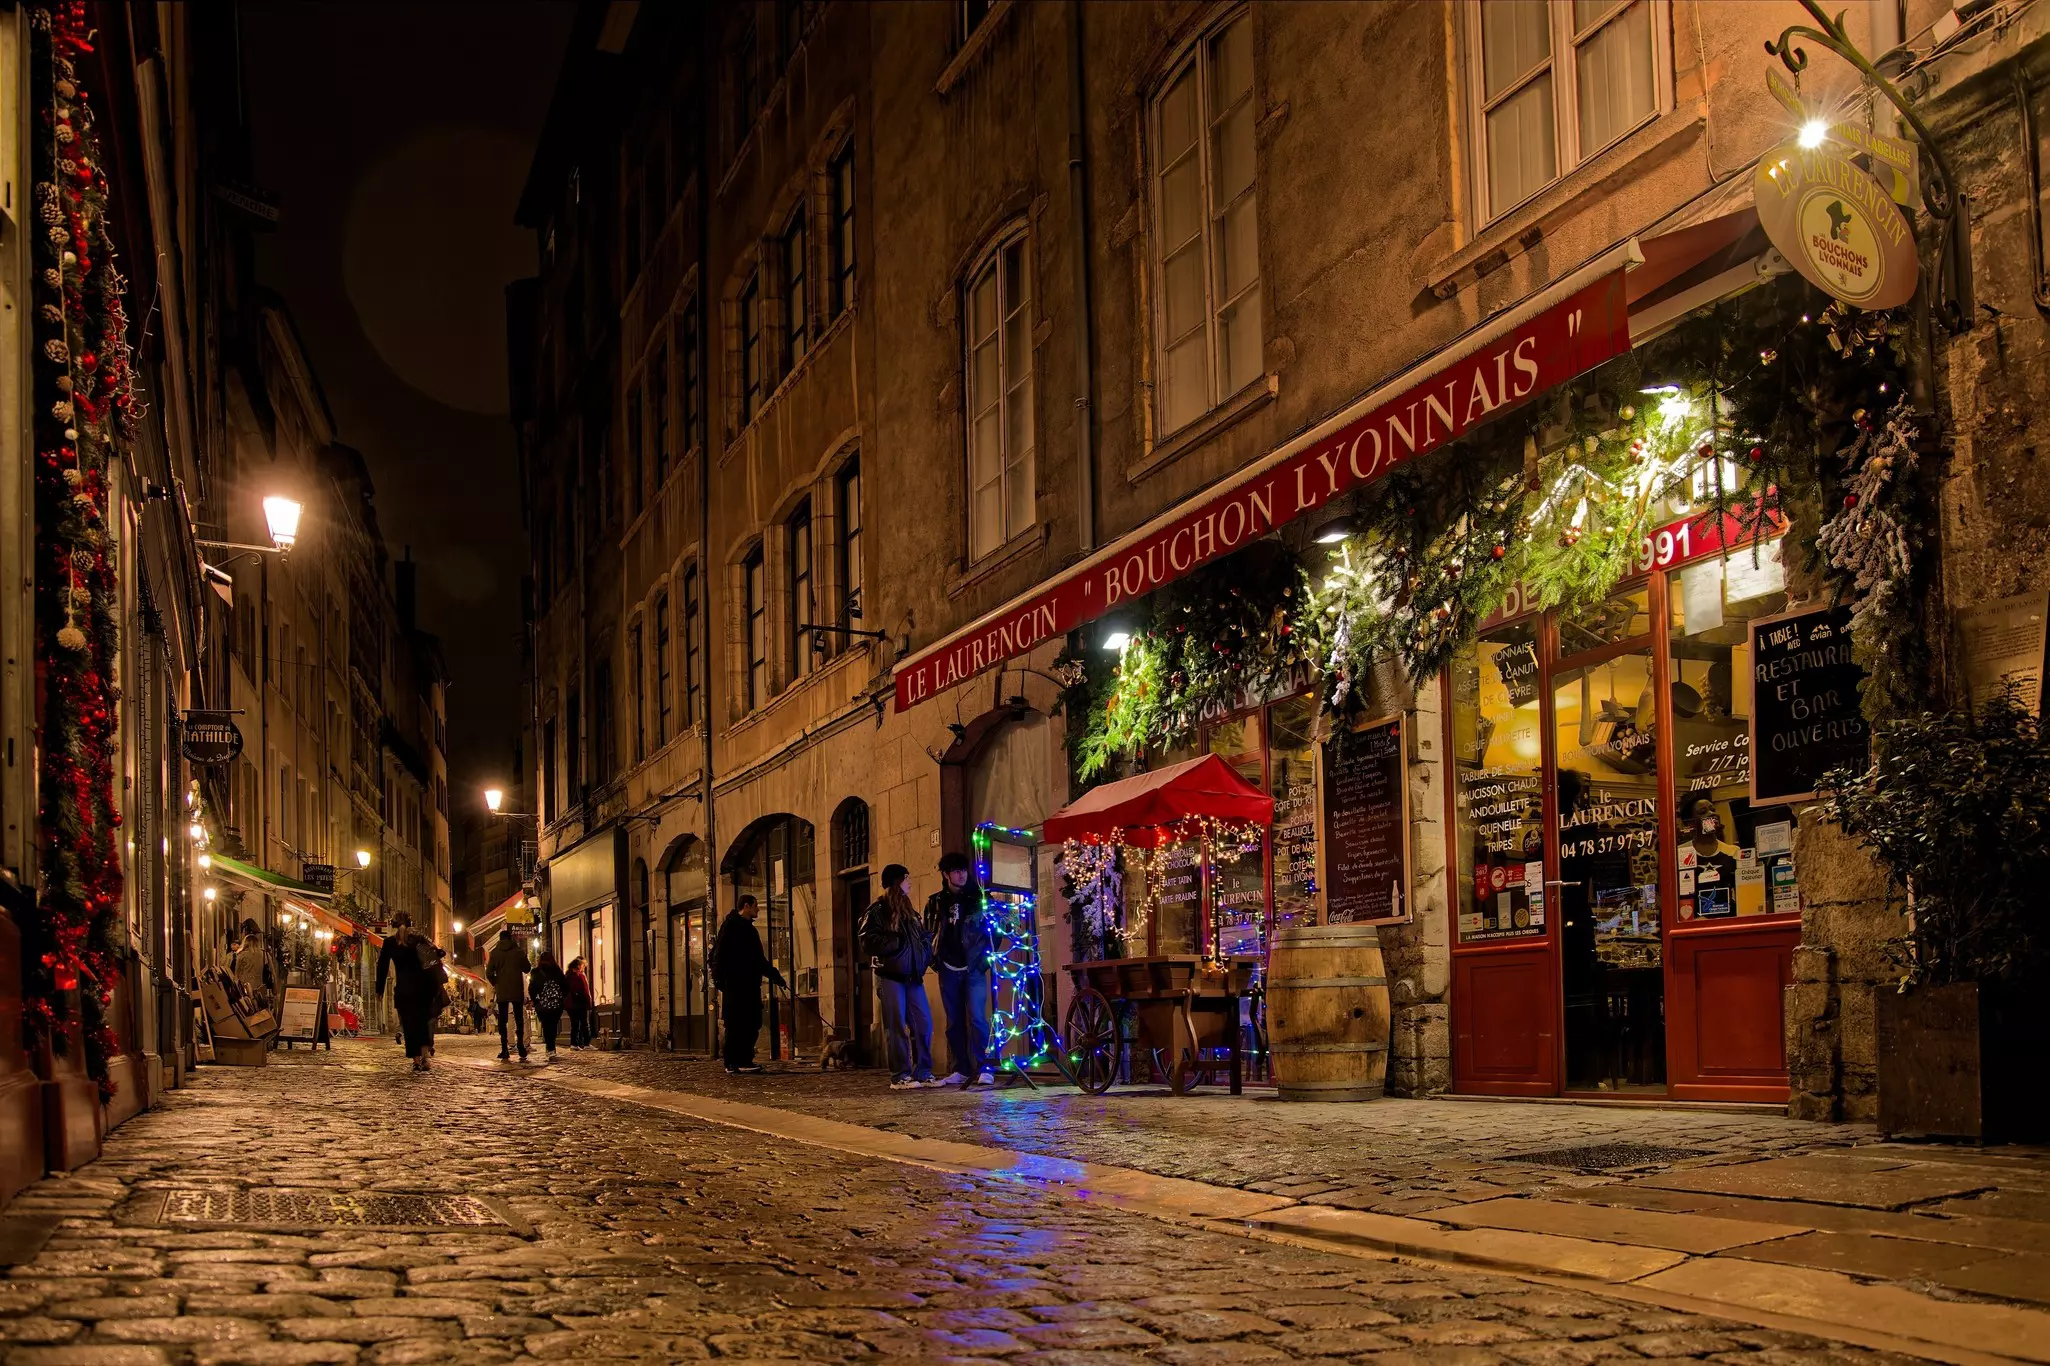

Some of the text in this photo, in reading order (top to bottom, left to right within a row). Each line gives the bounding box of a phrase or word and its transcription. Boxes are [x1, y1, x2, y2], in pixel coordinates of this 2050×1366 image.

[1798, 153, 1906, 248] LAURENCIN
[1812, 235, 1868, 269] BOUCHONS
[1819, 250, 1863, 278] LYONNAIS
[907, 662, 927, 705] LE
[936, 602, 1058, 692] LAURENCIN
[1104, 482, 1274, 608] BOUCHON
[1293, 336, 1539, 512] LYONNAIS
[1768, 625, 1793, 647] TABLE
[1810, 629, 1832, 641] evian
[1489, 640, 1535, 662] YONNAISE
[1787, 638, 1801, 651] AVEC
[1505, 661, 1535, 680] CANUT
[1756, 643, 1852, 682] RESTAURA
[1607, 732, 1650, 753] LYONNAIS
[1685, 739, 1729, 757] Service
[1708, 754, 1735, 772] 7/7
[1460, 768, 1489, 784] TABLIER
[1491, 765, 1503, 777] DE
[1690, 774, 1721, 792] 11h30
[1288, 786, 1301, 798] POT
[1507, 776, 1538, 793] CHAUD
[1273, 799, 1291, 812] COTE
[1293, 799, 1303, 808] DU
[1599, 789, 1612, 804] le
[1468, 797, 1531, 820] ANDOUILLETTE
[1559, 797, 1656, 829] LAURENCIN
[1290, 814, 1304, 826] POT
[1479, 818, 1522, 836] QUENELLE
[1283, 824, 1315, 839] BEAUJOLA
[1277, 846, 1290, 857] POT
[1487, 838, 1514, 854] TRIPES
[1561, 842, 1576, 859] 04
[1579, 839, 1595, 856] 78
[1597, 836, 1613, 854] 37
[1617, 833, 1633, 851] 97
[1637, 830, 1653, 848] 37
[1178, 874, 1193, 885] TATIN
[1232, 878, 1240, 889] le
[1282, 873, 1291, 884] DU
[1175, 890, 1197, 902] PRALINE
[1219, 889, 1263, 906] AURENCIN
